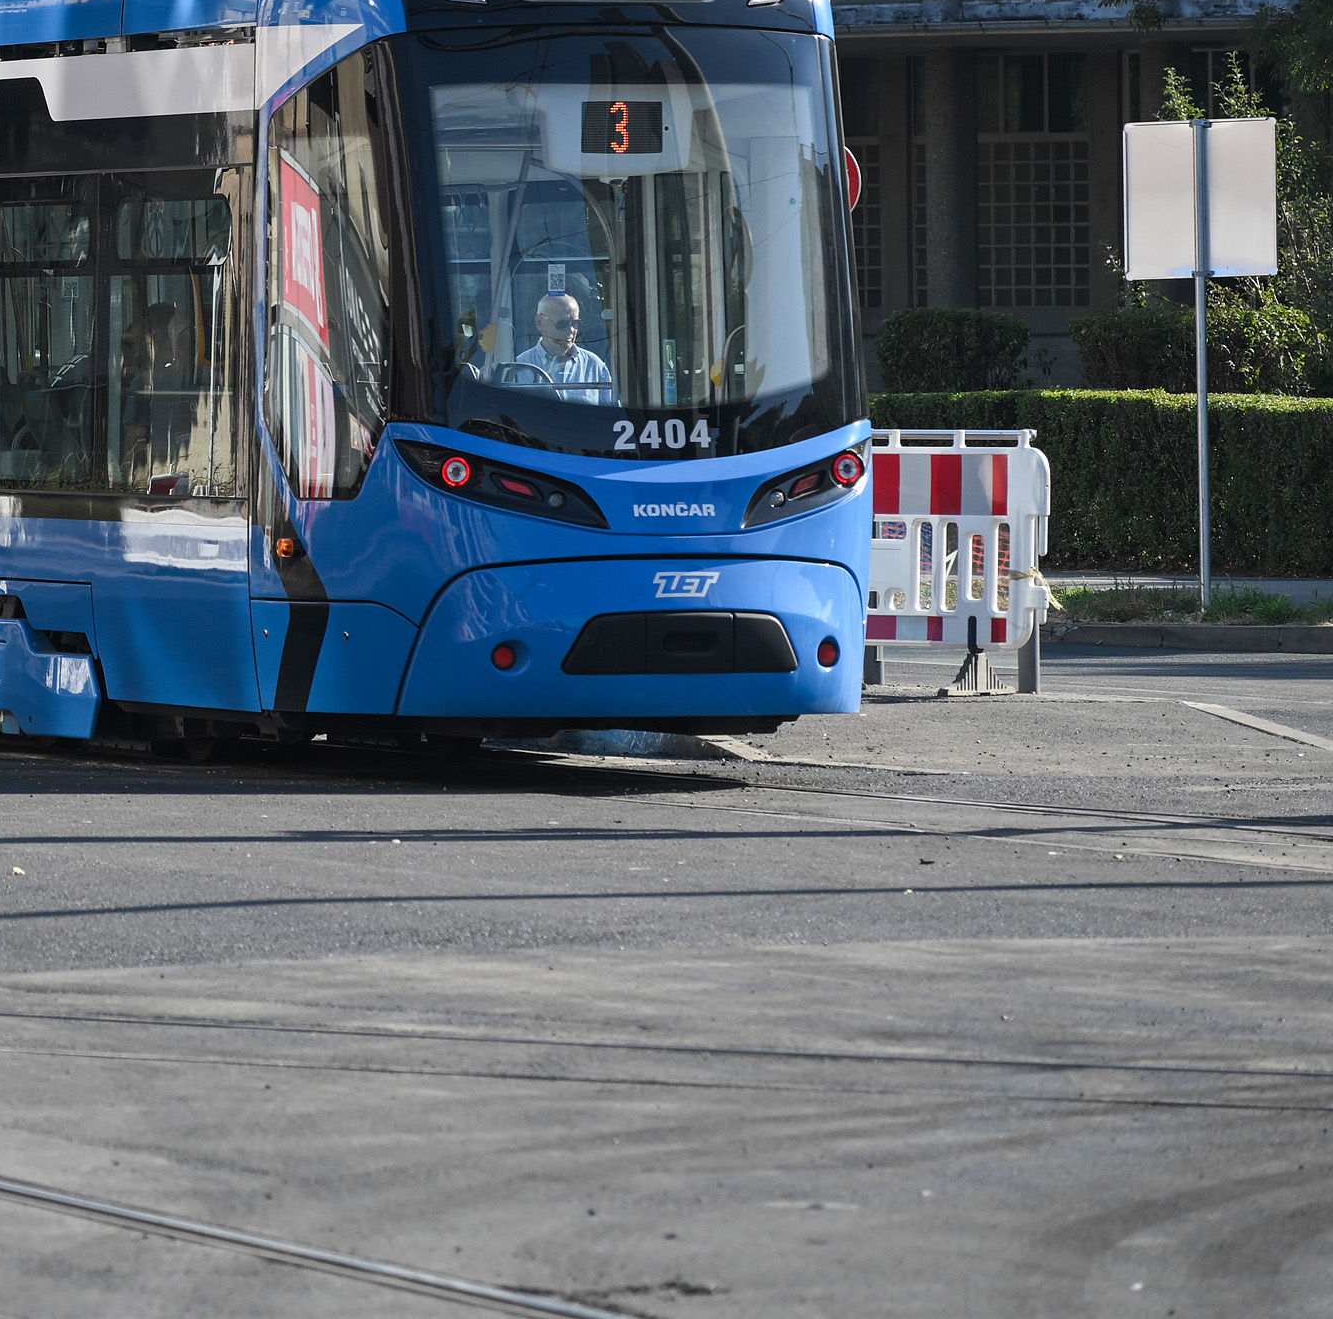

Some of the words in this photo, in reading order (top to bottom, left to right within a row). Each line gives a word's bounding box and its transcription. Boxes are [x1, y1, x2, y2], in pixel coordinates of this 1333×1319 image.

[610, 101, 629, 154] 3
[613, 418, 712, 450] 2404
[633, 501, 716, 518] KONČAR
[652, 571, 721, 599] ZET
